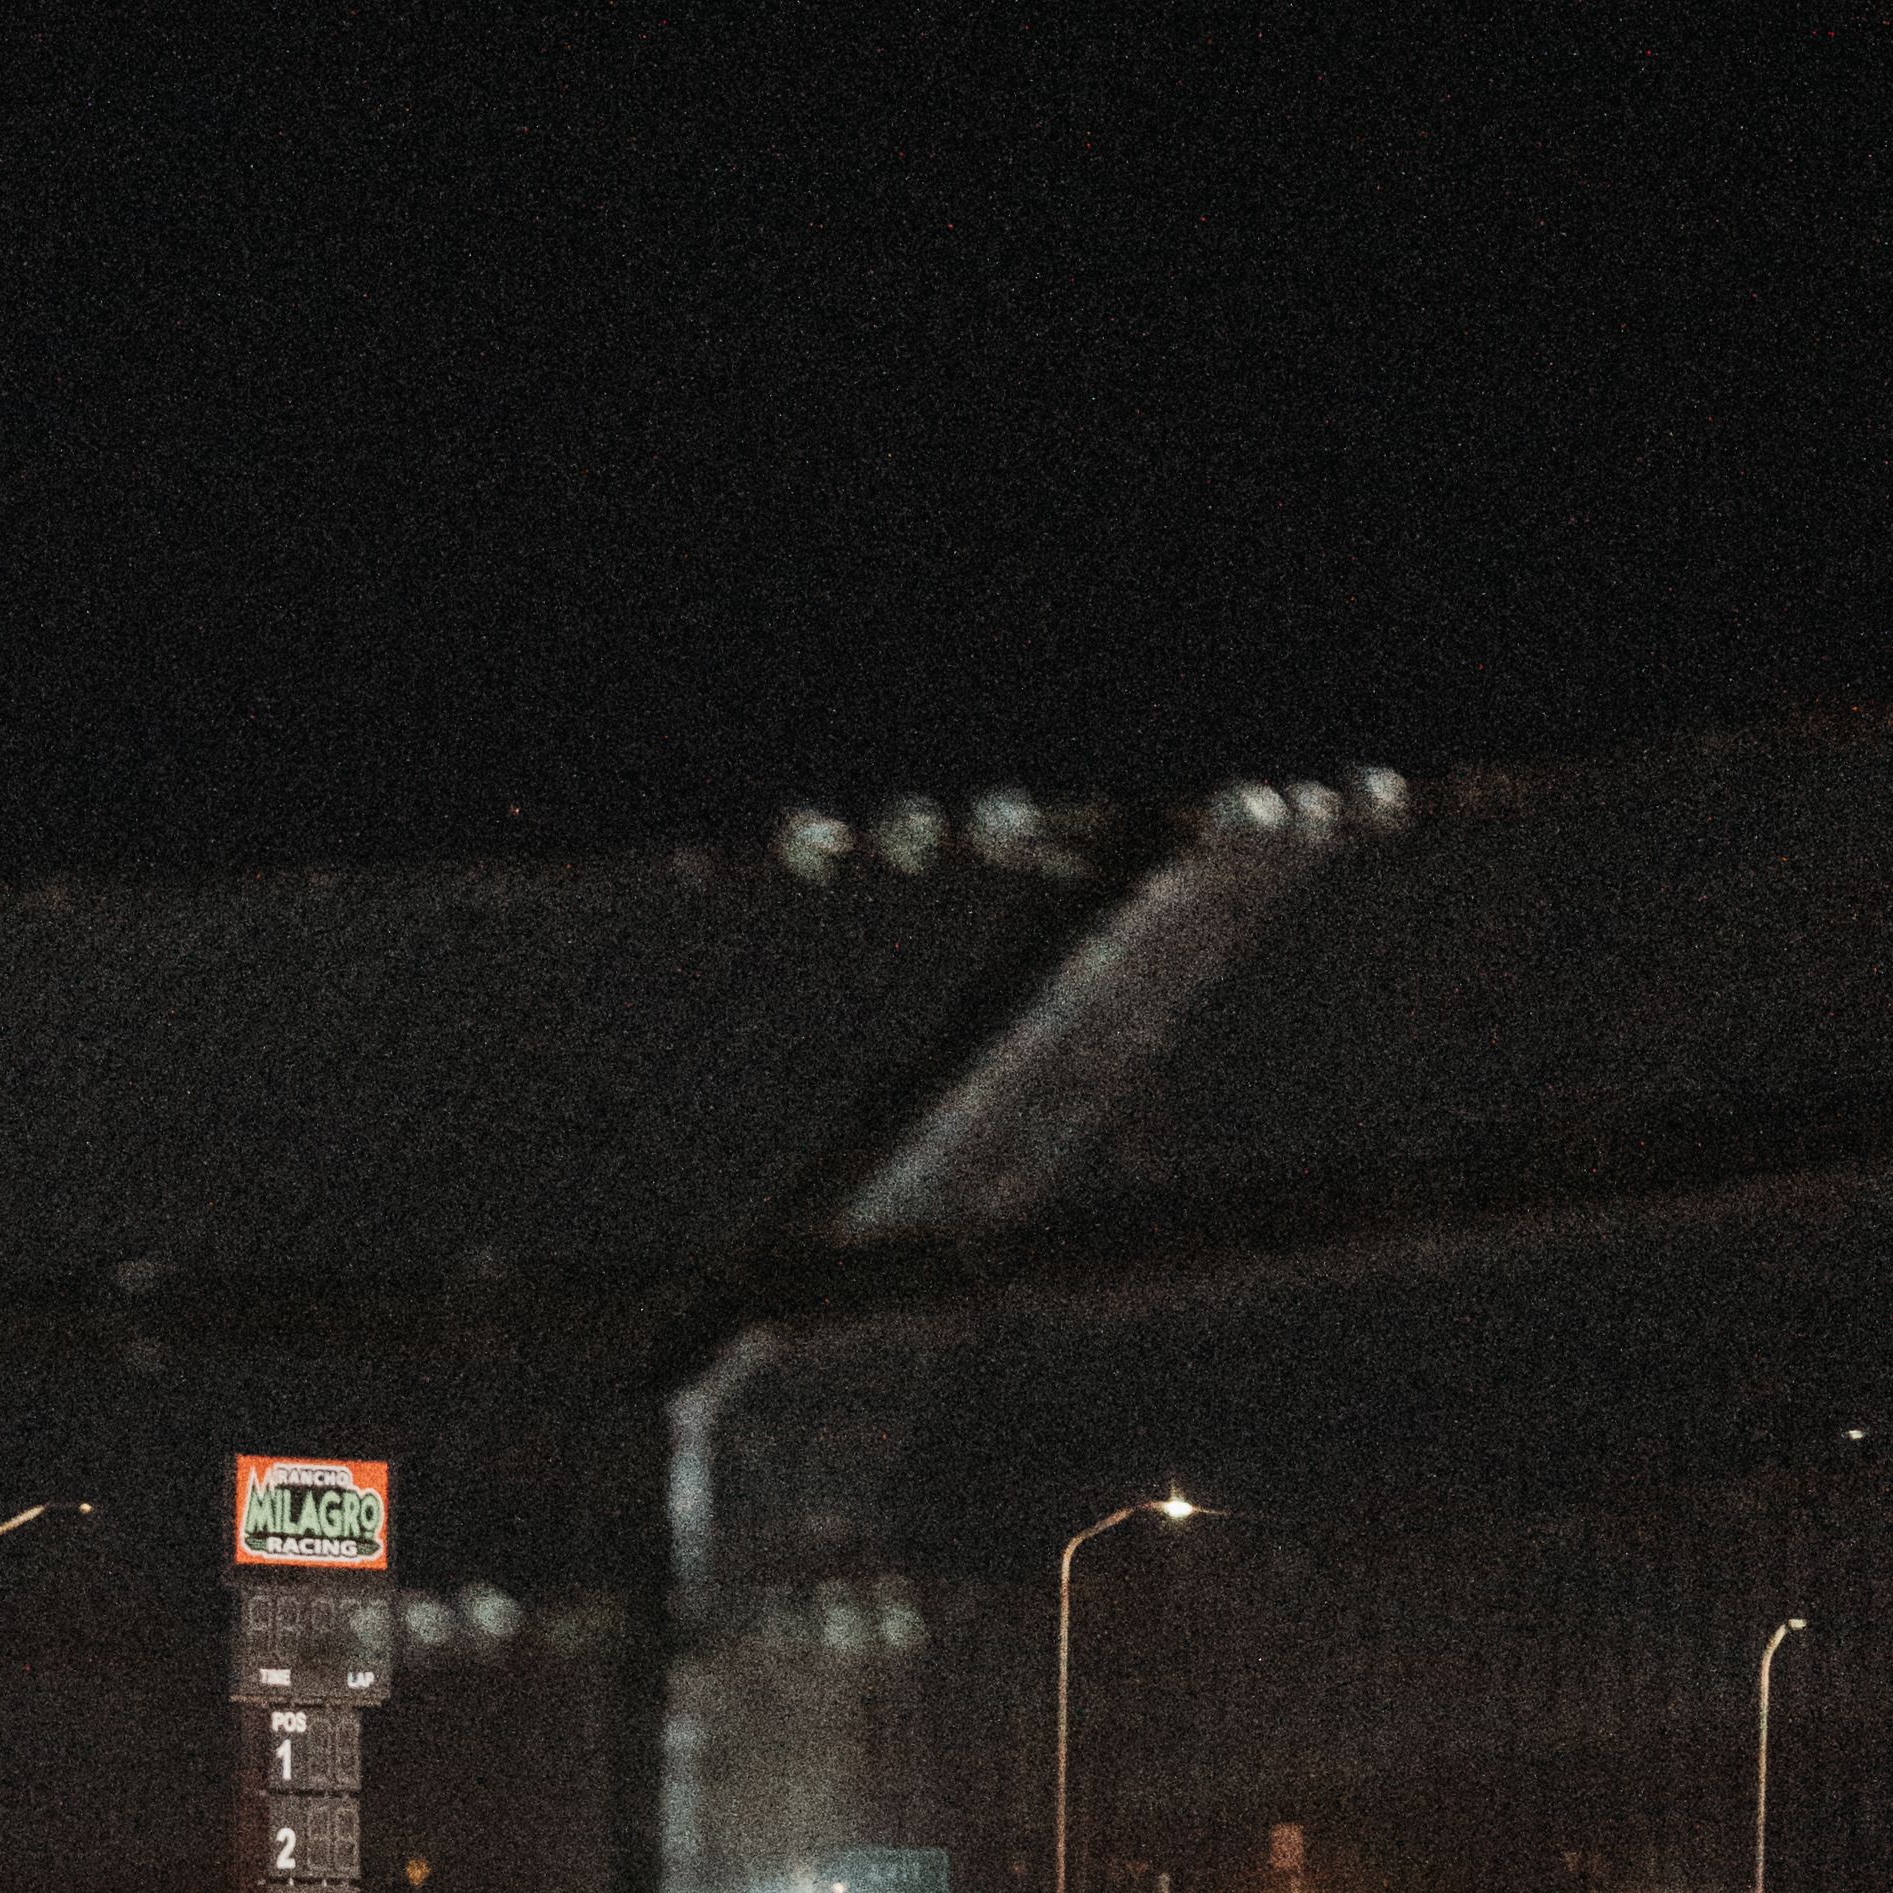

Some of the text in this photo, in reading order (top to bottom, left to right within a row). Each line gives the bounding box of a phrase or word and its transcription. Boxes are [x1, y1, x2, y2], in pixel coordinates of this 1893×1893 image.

[275, 1468, 350, 1487] RANCHO
[245, 1484, 381, 1539] MILAGRO
[266, 1536, 358, 1557] RACING
[347, 1671, 375, 1689] LAP
[271, 1711, 307, 1732] POS
[276, 1741, 292, 1780] 1
[276, 1828, 295, 1869] 2
